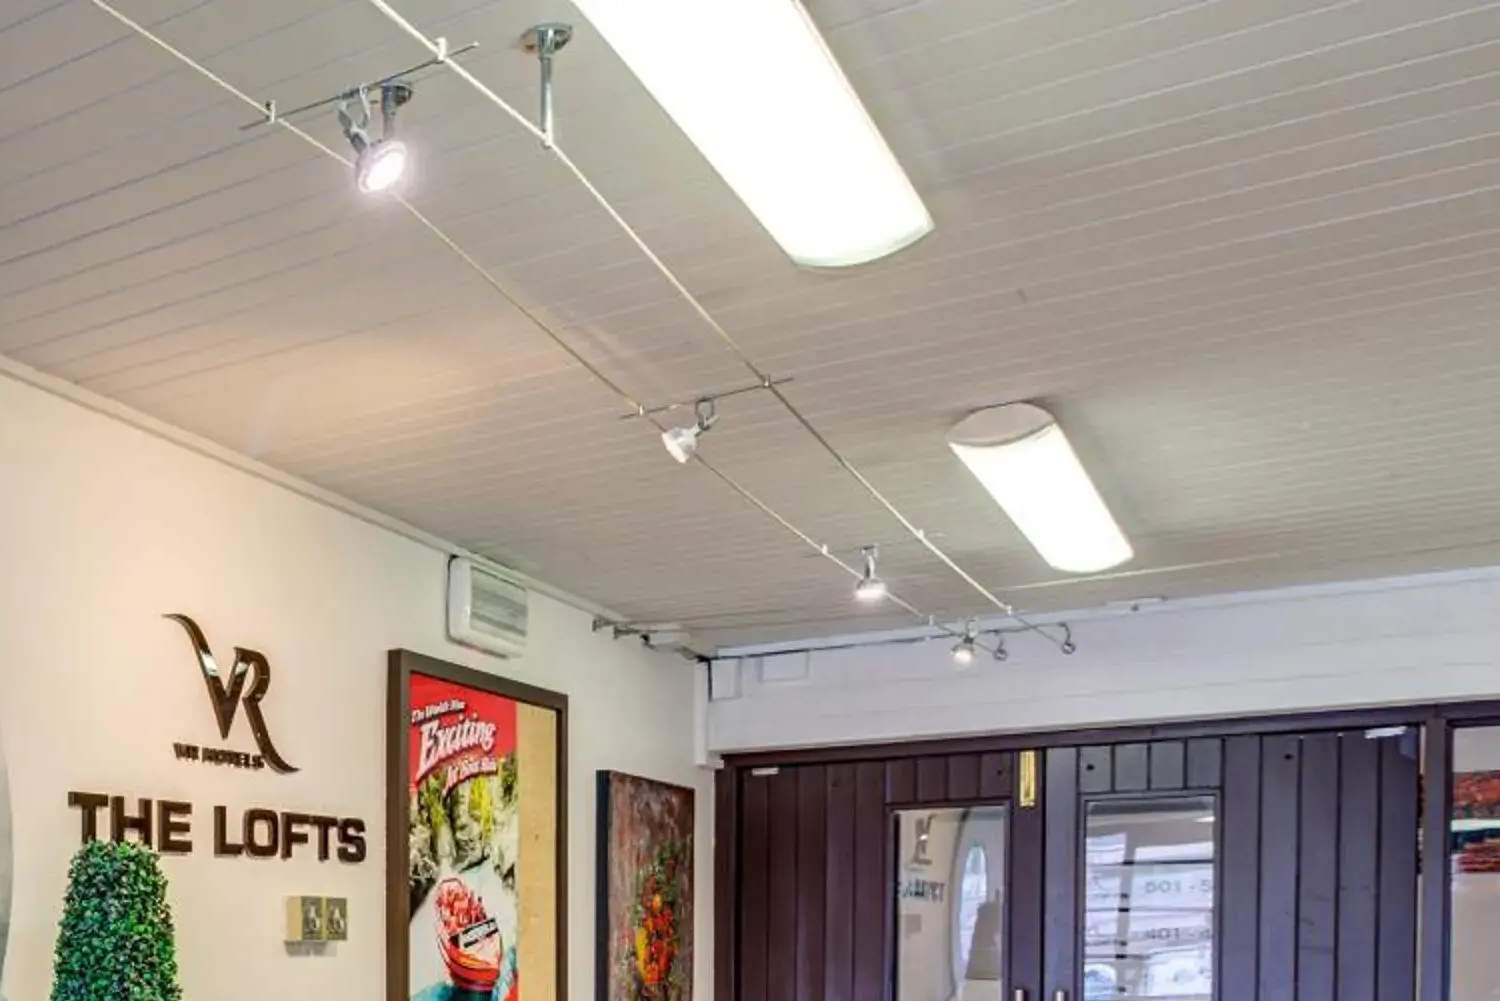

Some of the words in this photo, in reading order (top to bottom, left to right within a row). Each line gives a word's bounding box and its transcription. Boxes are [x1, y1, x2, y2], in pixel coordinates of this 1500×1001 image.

[162, 613, 301, 774] VR
[202, 747, 265, 770] HOTELS
[415, 712, 497, 782] Exciting
[68, 790, 194, 856] THE
[213, 805, 368, 863] LOFTS
